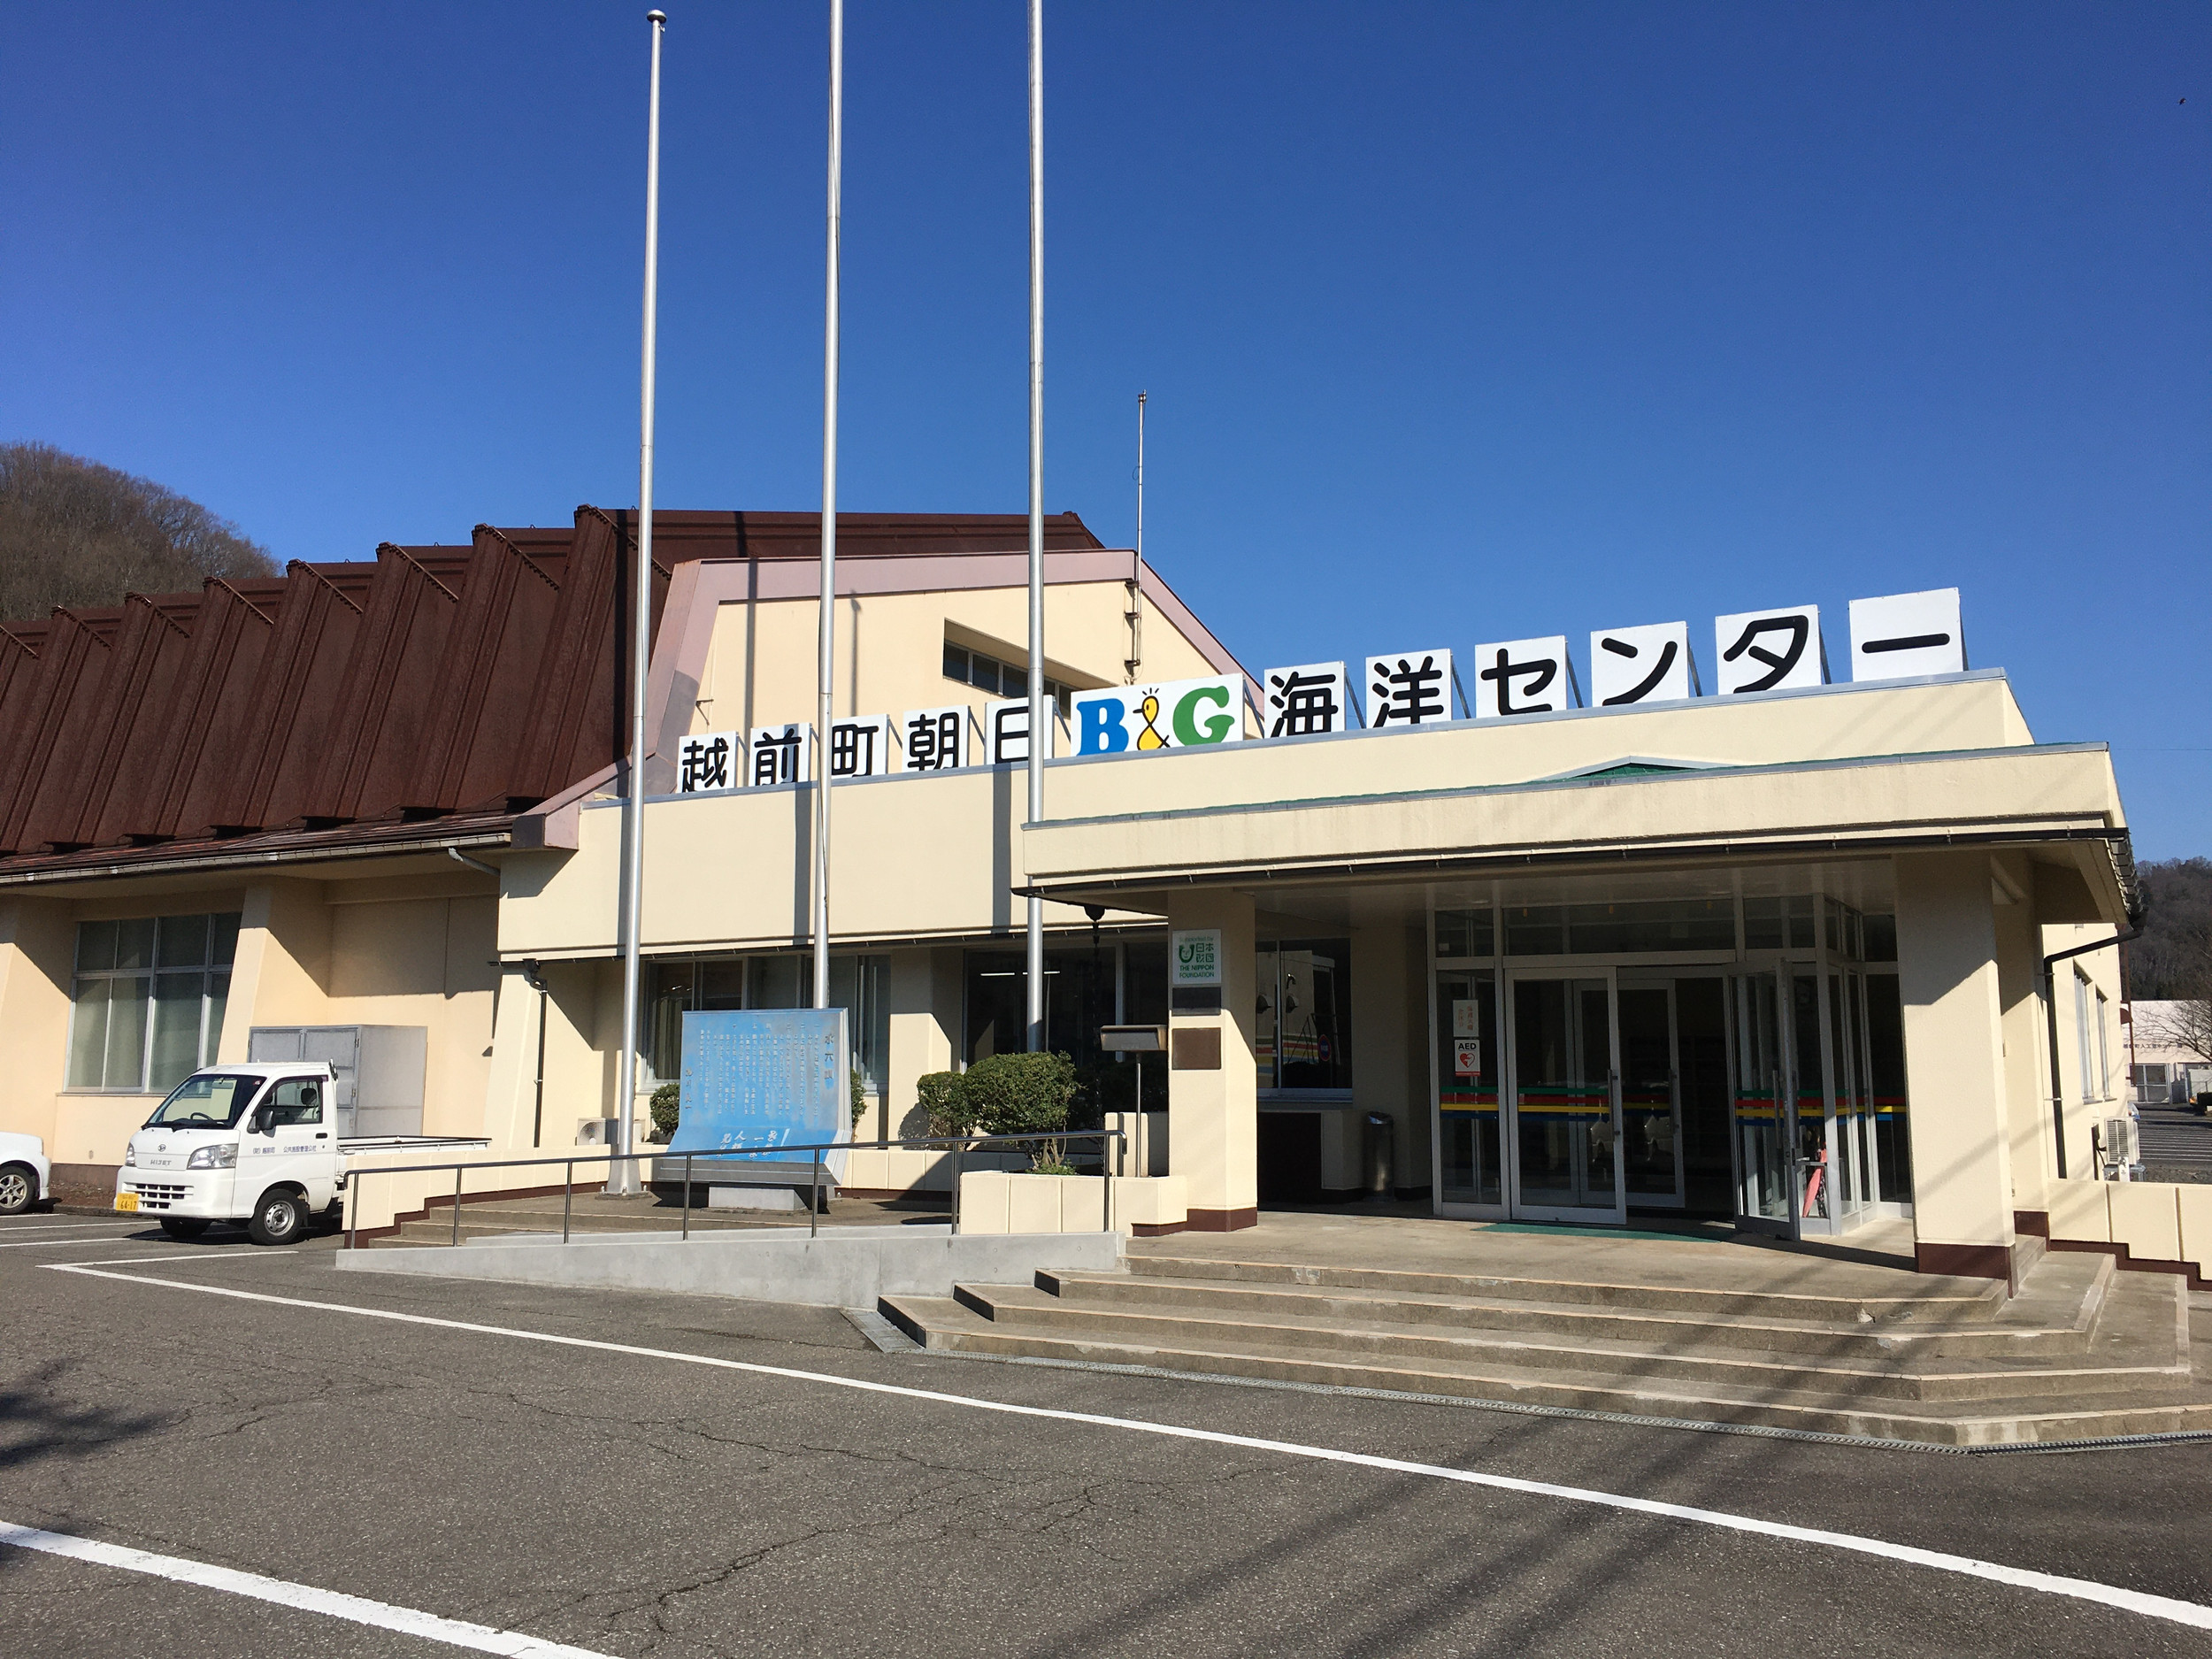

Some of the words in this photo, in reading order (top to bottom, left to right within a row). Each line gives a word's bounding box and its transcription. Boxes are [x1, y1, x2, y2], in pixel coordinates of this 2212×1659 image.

[1076, 686, 1235, 757] B&G
[1271, 615, 1950, 737] 海洋センター
[1196, 943, 1214, 952] 日本
